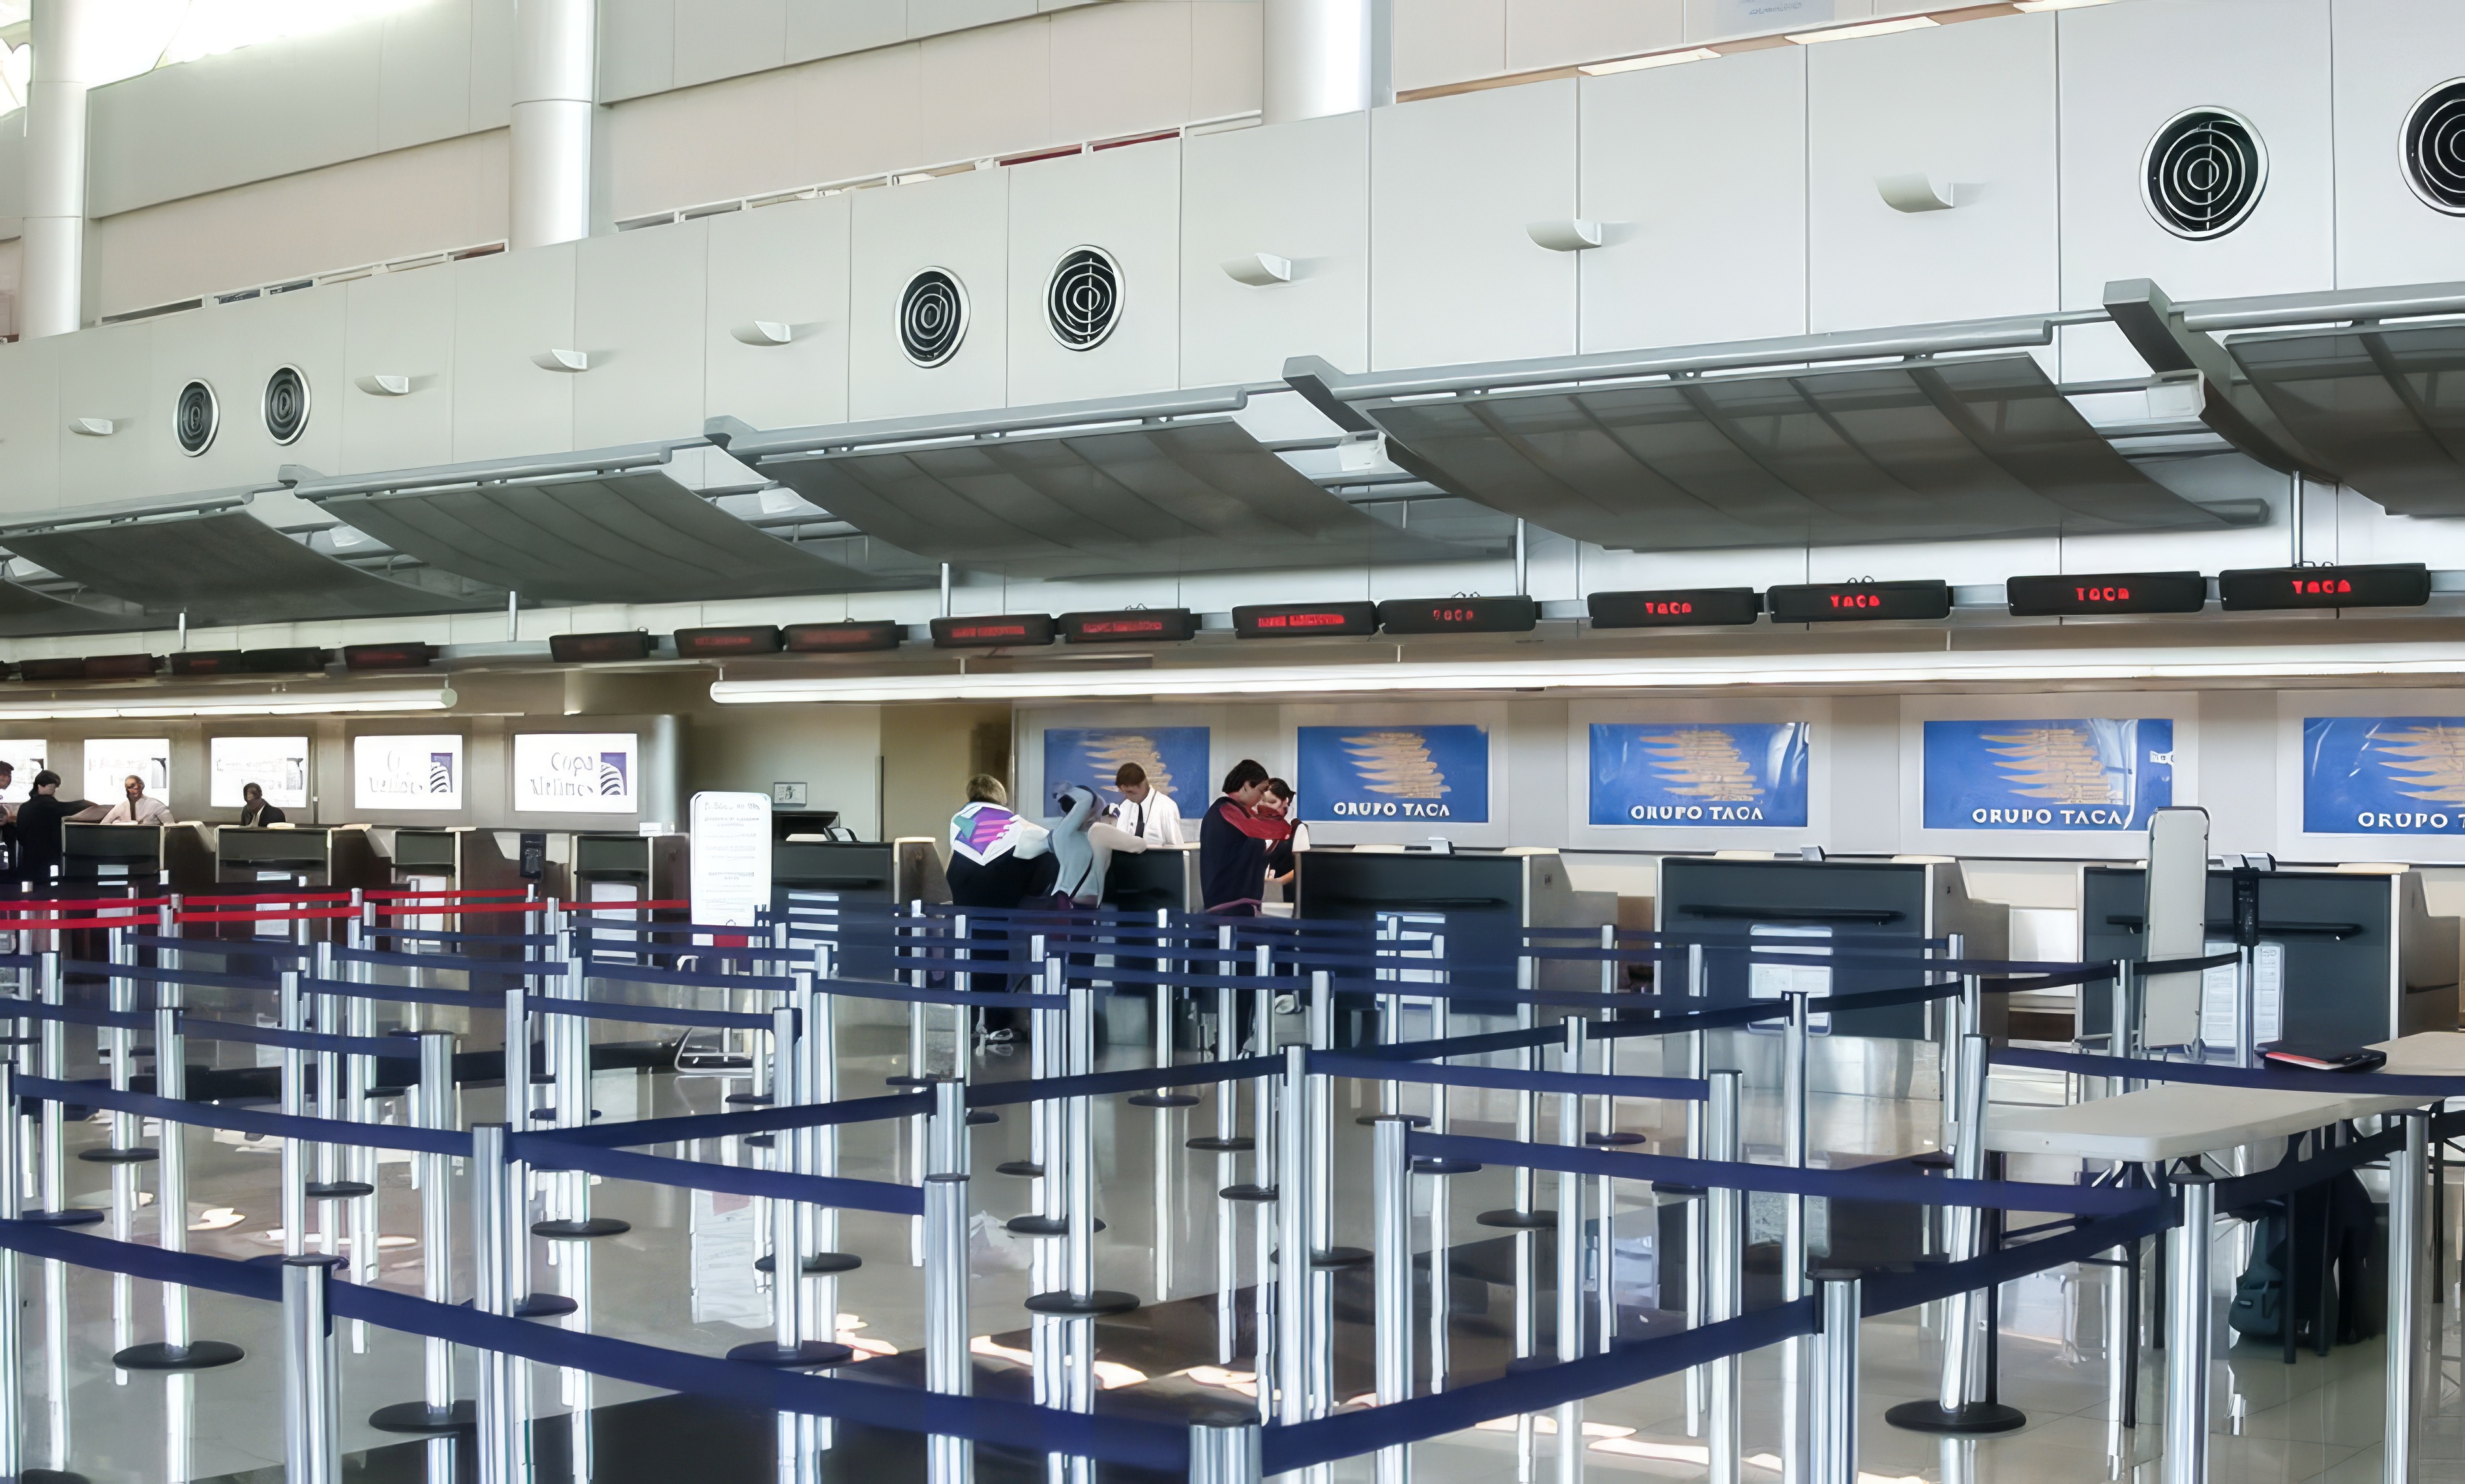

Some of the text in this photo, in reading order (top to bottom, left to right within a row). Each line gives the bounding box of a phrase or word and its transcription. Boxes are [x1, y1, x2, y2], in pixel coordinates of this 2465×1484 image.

[1402, 803, 1450, 817] TACA
[1709, 807, 1763, 820] TACA
[2059, 810, 2122, 825] TACA
